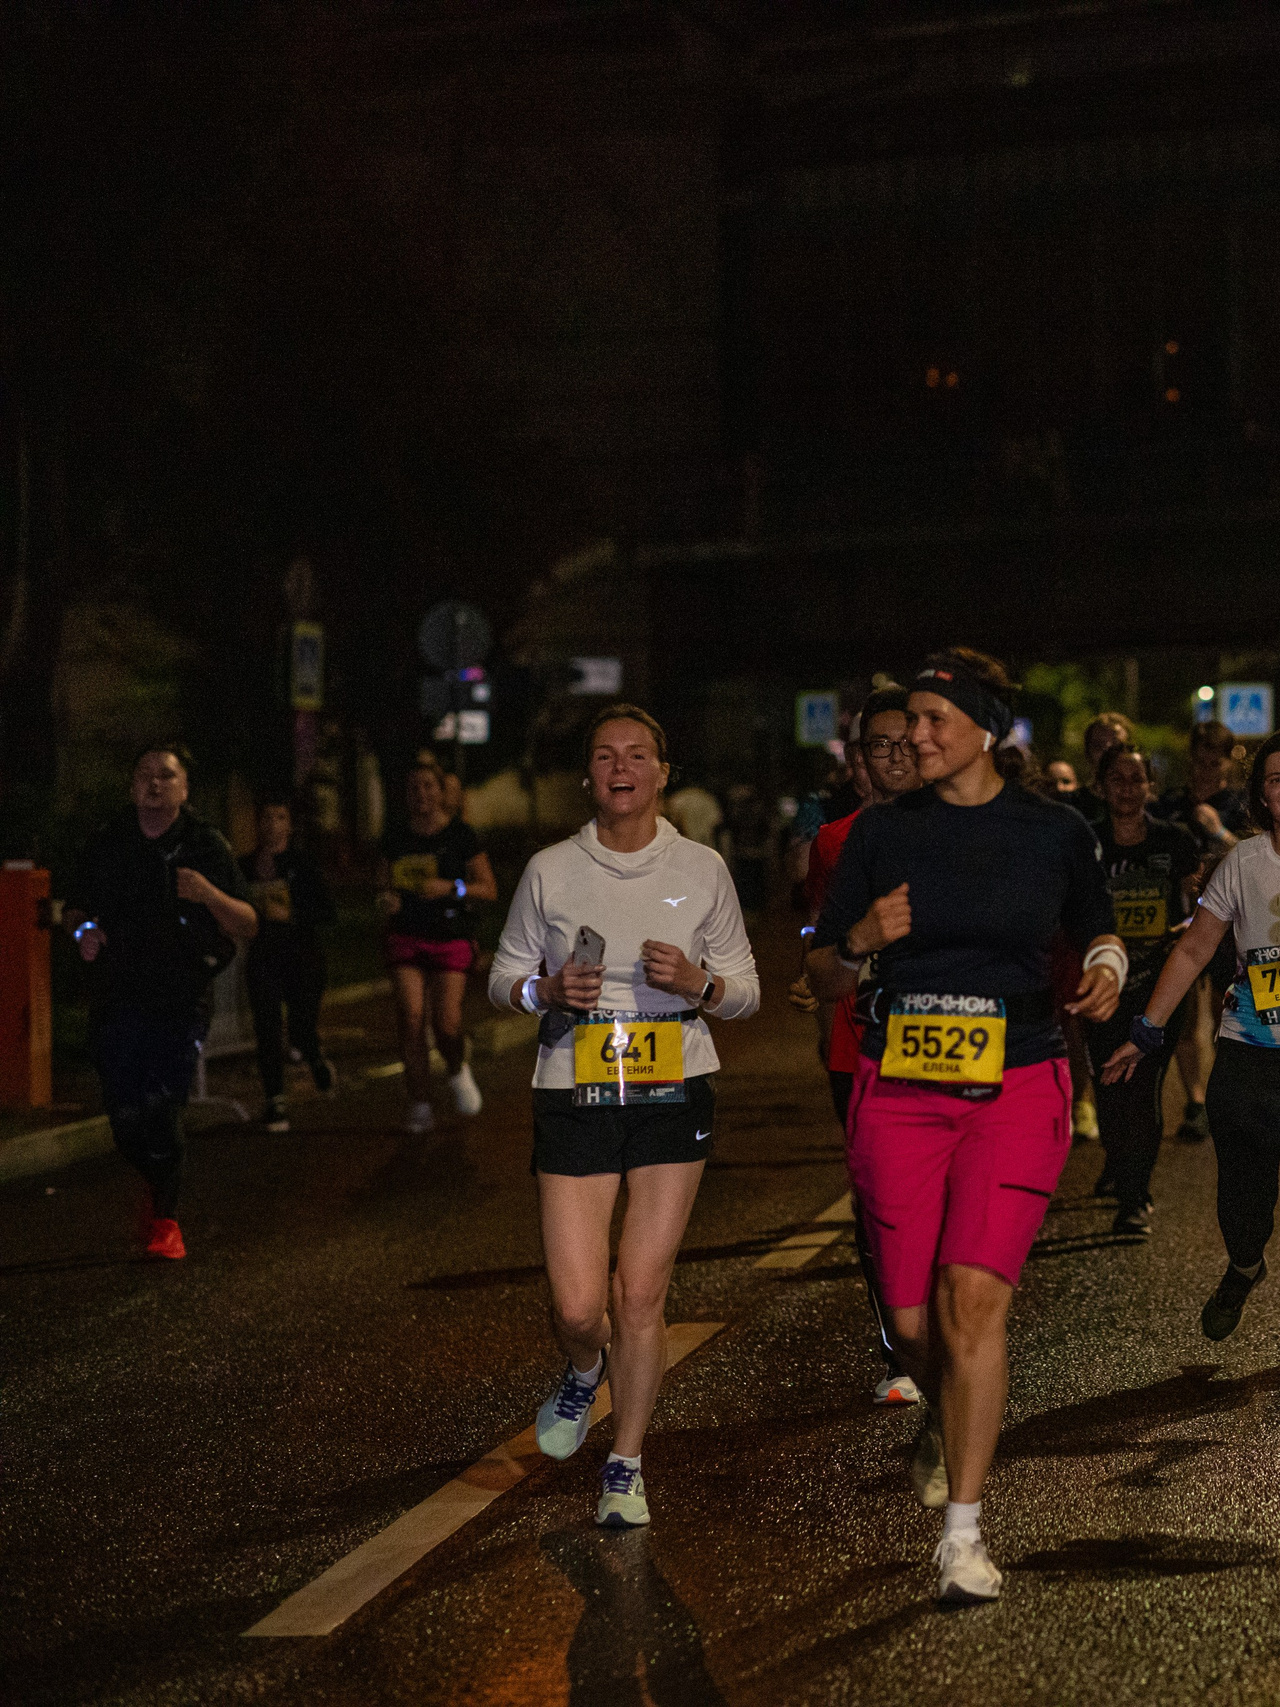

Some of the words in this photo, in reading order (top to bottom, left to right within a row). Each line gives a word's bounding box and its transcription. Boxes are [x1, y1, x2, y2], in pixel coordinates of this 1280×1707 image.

[1120, 905, 1158, 925] 759
[600, 1031, 657, 1063] 641
[902, 1024, 990, 1061] 5529
[922, 1061, 962, 1074] ЕЛЕНА
